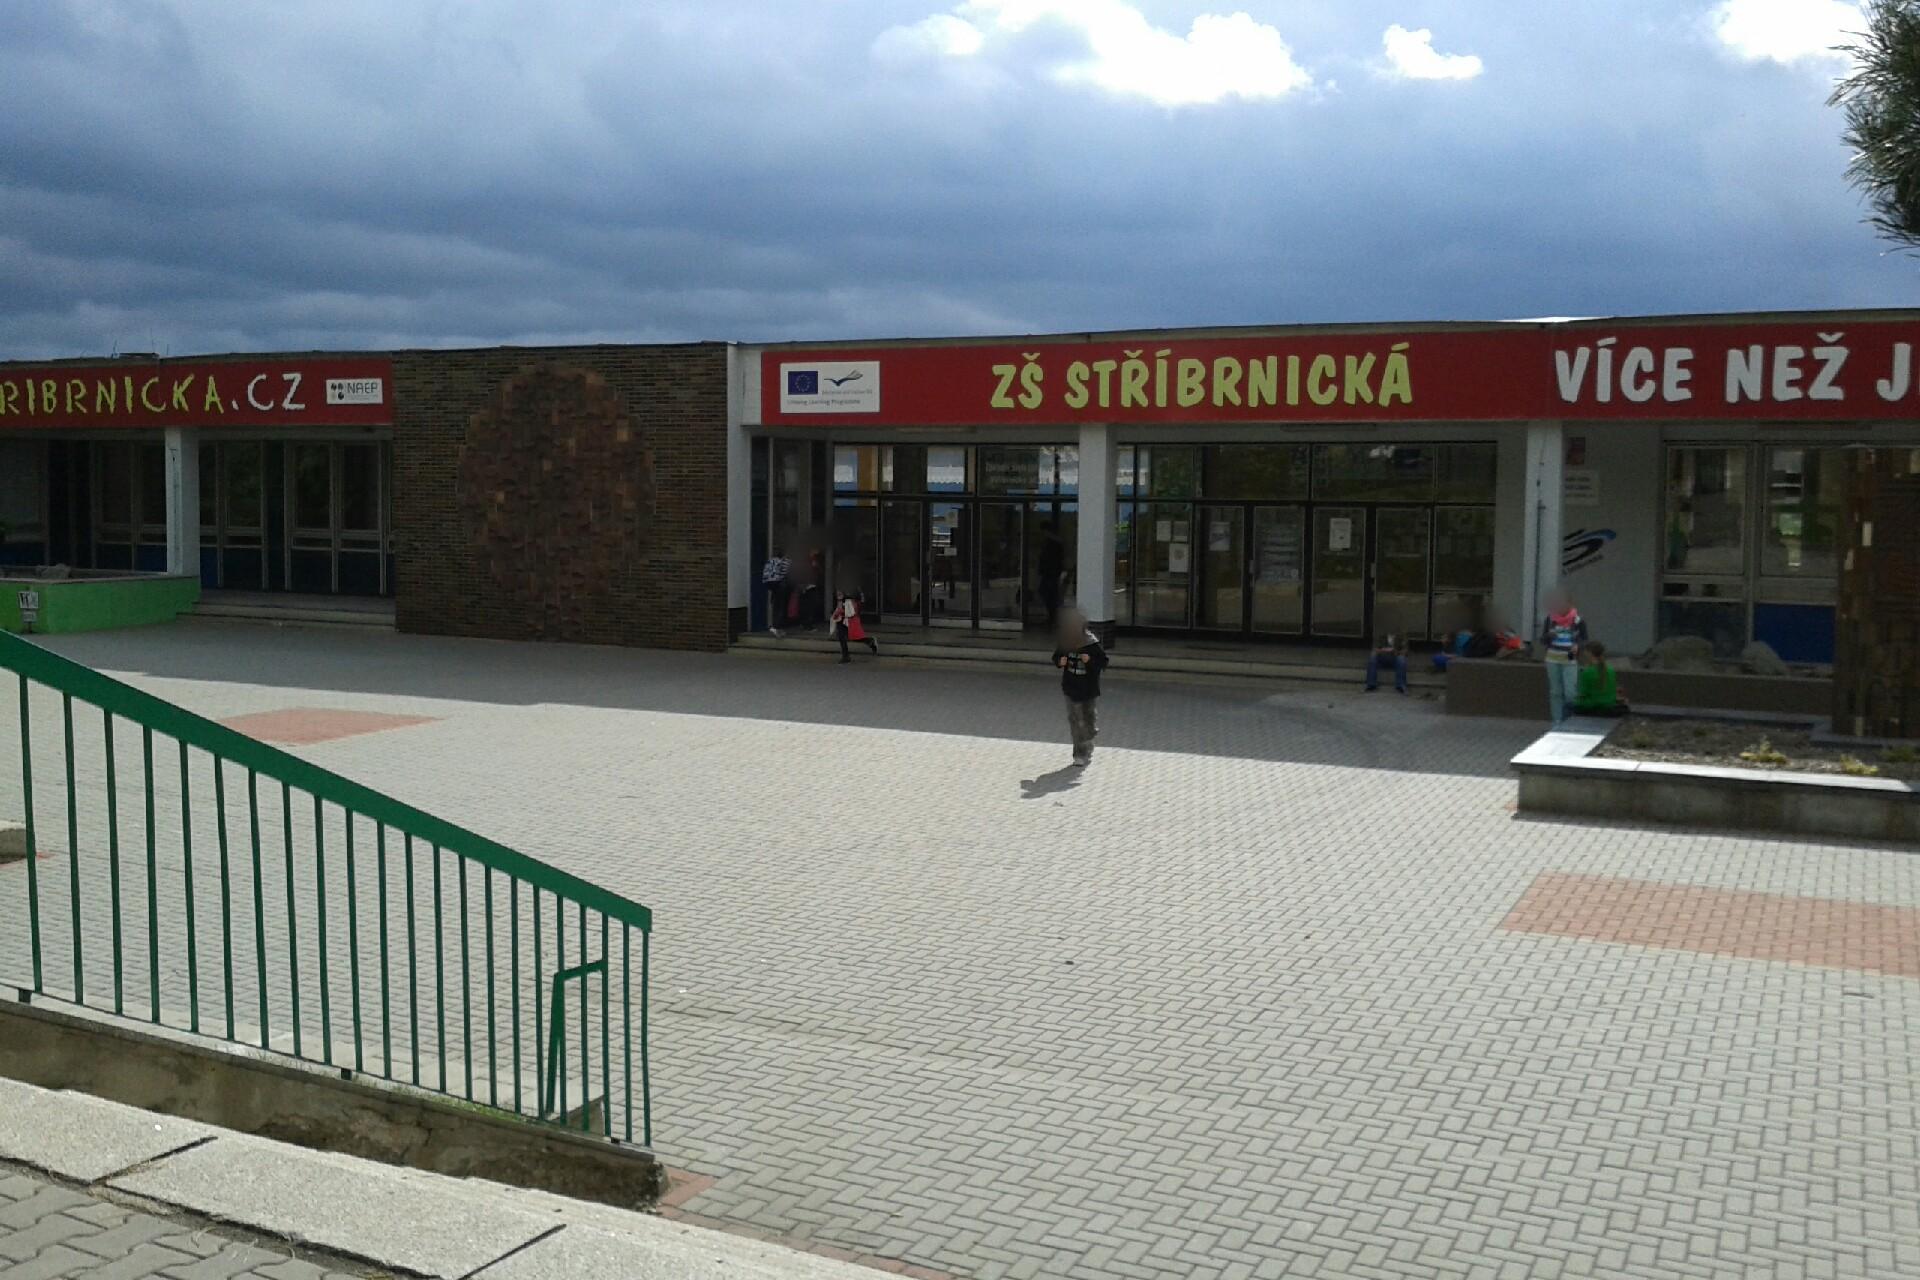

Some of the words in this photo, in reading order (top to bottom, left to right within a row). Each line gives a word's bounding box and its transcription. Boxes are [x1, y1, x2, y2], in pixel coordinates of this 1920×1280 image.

[347, 382, 378, 394] NAEP
[990, 352, 1044, 409] ZŠ
[1064, 342, 1413, 409] STŘÍBRNICKÁ
[1555, 337, 1694, 403] VÍCE
[1726, 332, 1849, 403] NEŽ
[1876, 342, 1920, 402] J
